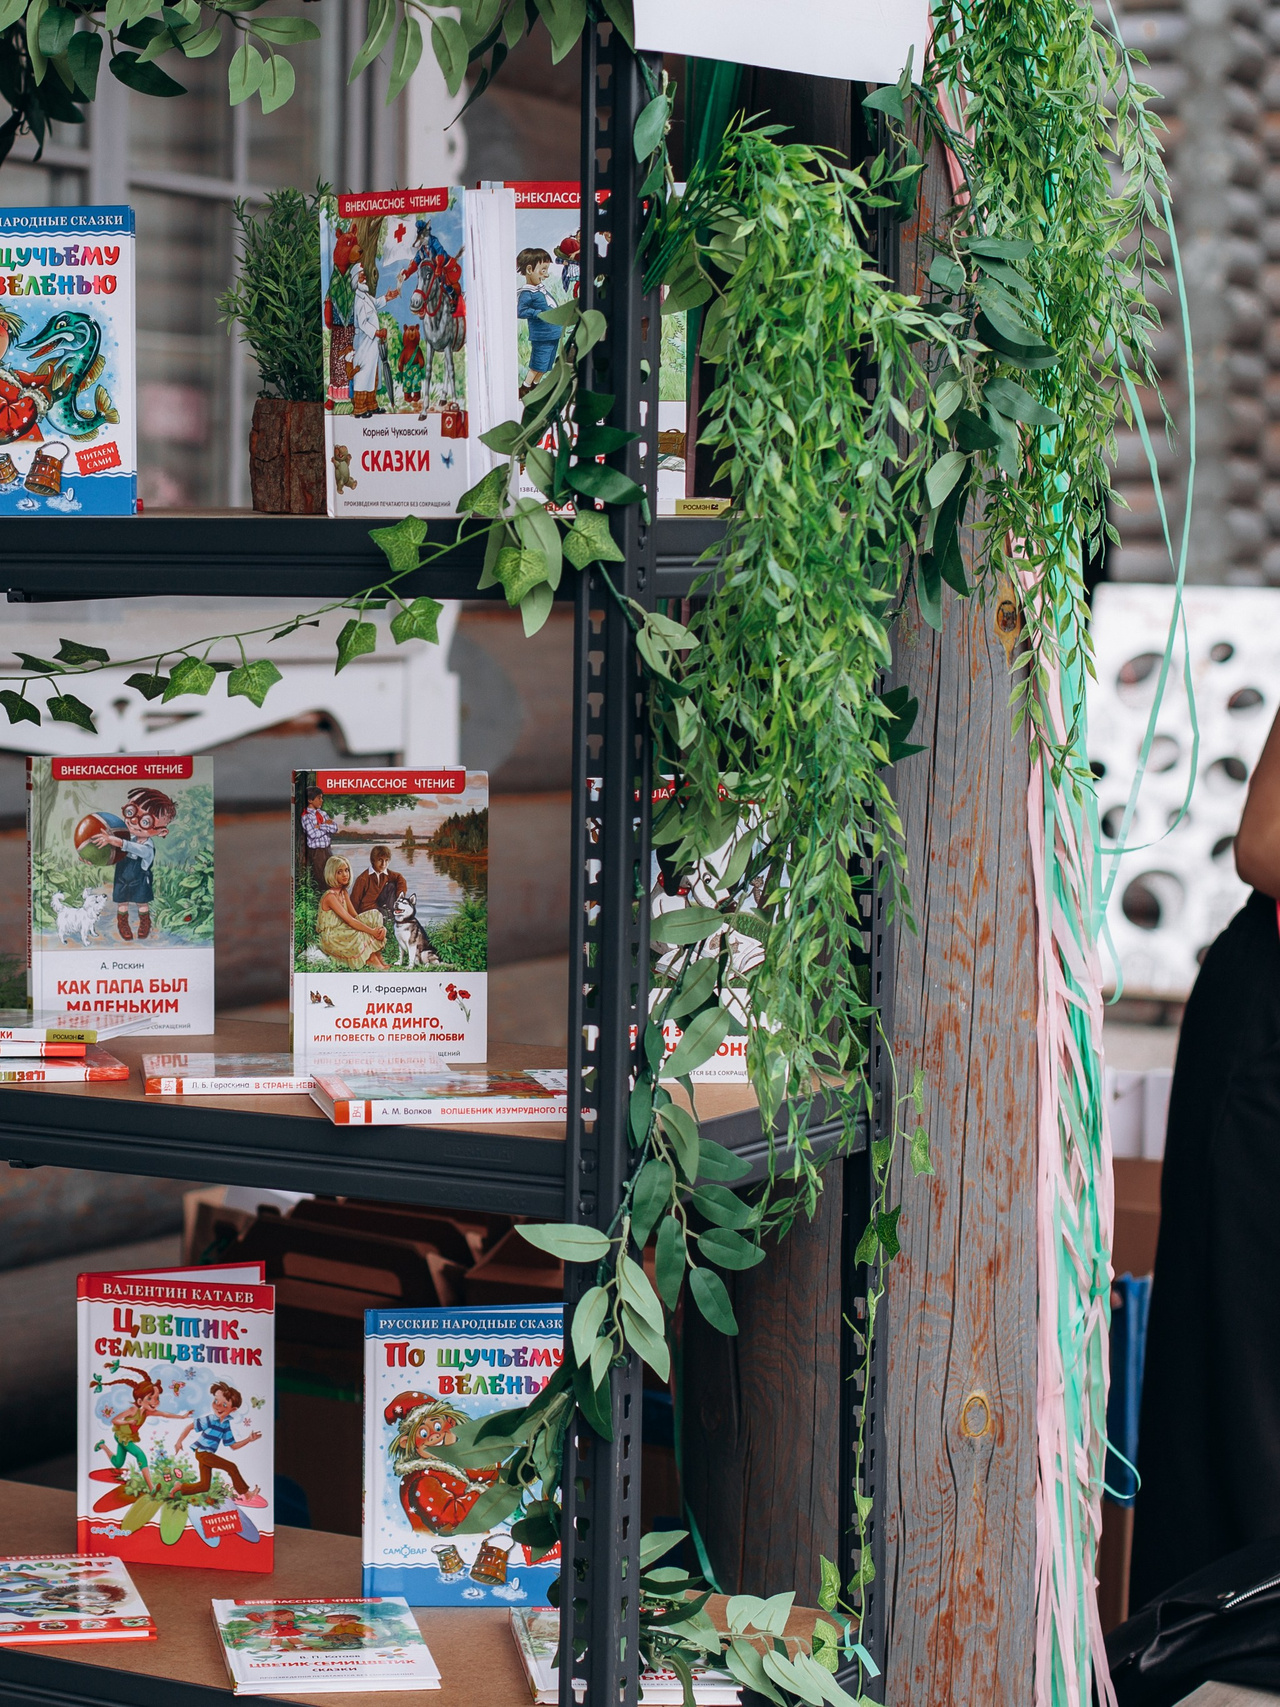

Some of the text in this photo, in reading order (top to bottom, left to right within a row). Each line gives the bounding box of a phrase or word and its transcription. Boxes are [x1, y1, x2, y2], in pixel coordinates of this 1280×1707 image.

[345, 194, 441, 213] ВНЕКЛАССНОЕ ЧТЕНИЕ
[515, 192, 601, 204] ВНЕКЛАССЕ
[70, 215, 123, 226] СКАЗКИ
[363, 427, 428, 438] Корней Чуковский
[79, 446, 115, 462] ЧИТАЕМ
[86, 456, 113, 470] САМИ
[361, 450, 430, 472] СКАЗКИ
[61, 764, 183, 775] ВНЕКЛАССНОЕ ЧТЕНИЕ
[326, 778, 455, 789] ВНЕКЛАССНОЕ ЧТЕНИЕ
[100, 962, 145, 970] А. Раскин
[57, 978, 188, 995] КАК ПАПА БЫЛ
[352, 984, 427, 995] Р. И. Фраерман
[67, 998, 179, 1014] МАЛЕНЬКИМ
[366, 1003, 412, 1015] ДИКАЯ
[335, 1017, 443, 1030] СОБАКА ДИНГО,
[334, 1034, 375, 1042] ПОВЕСТЬ
[388, 1032, 426, 1042] ПЕРВОЙ
[429, 1033, 465, 1041] ЛЮБВИ
[440, 1107, 493, 1115] ВОЛШЕБНИК
[495, 1106, 556, 1115] ИЗУМРУДНОГО
[103, 1283, 254, 1303] ВАЛЕНТИН КАТАЕВ
[379, 1319, 563, 1330] РУССКИЕ НАРОДНЫЕ СКАЗК
[205, 1514, 237, 1526] ЧИТАЕМ
[211, 1523, 235, 1534] САМИ
